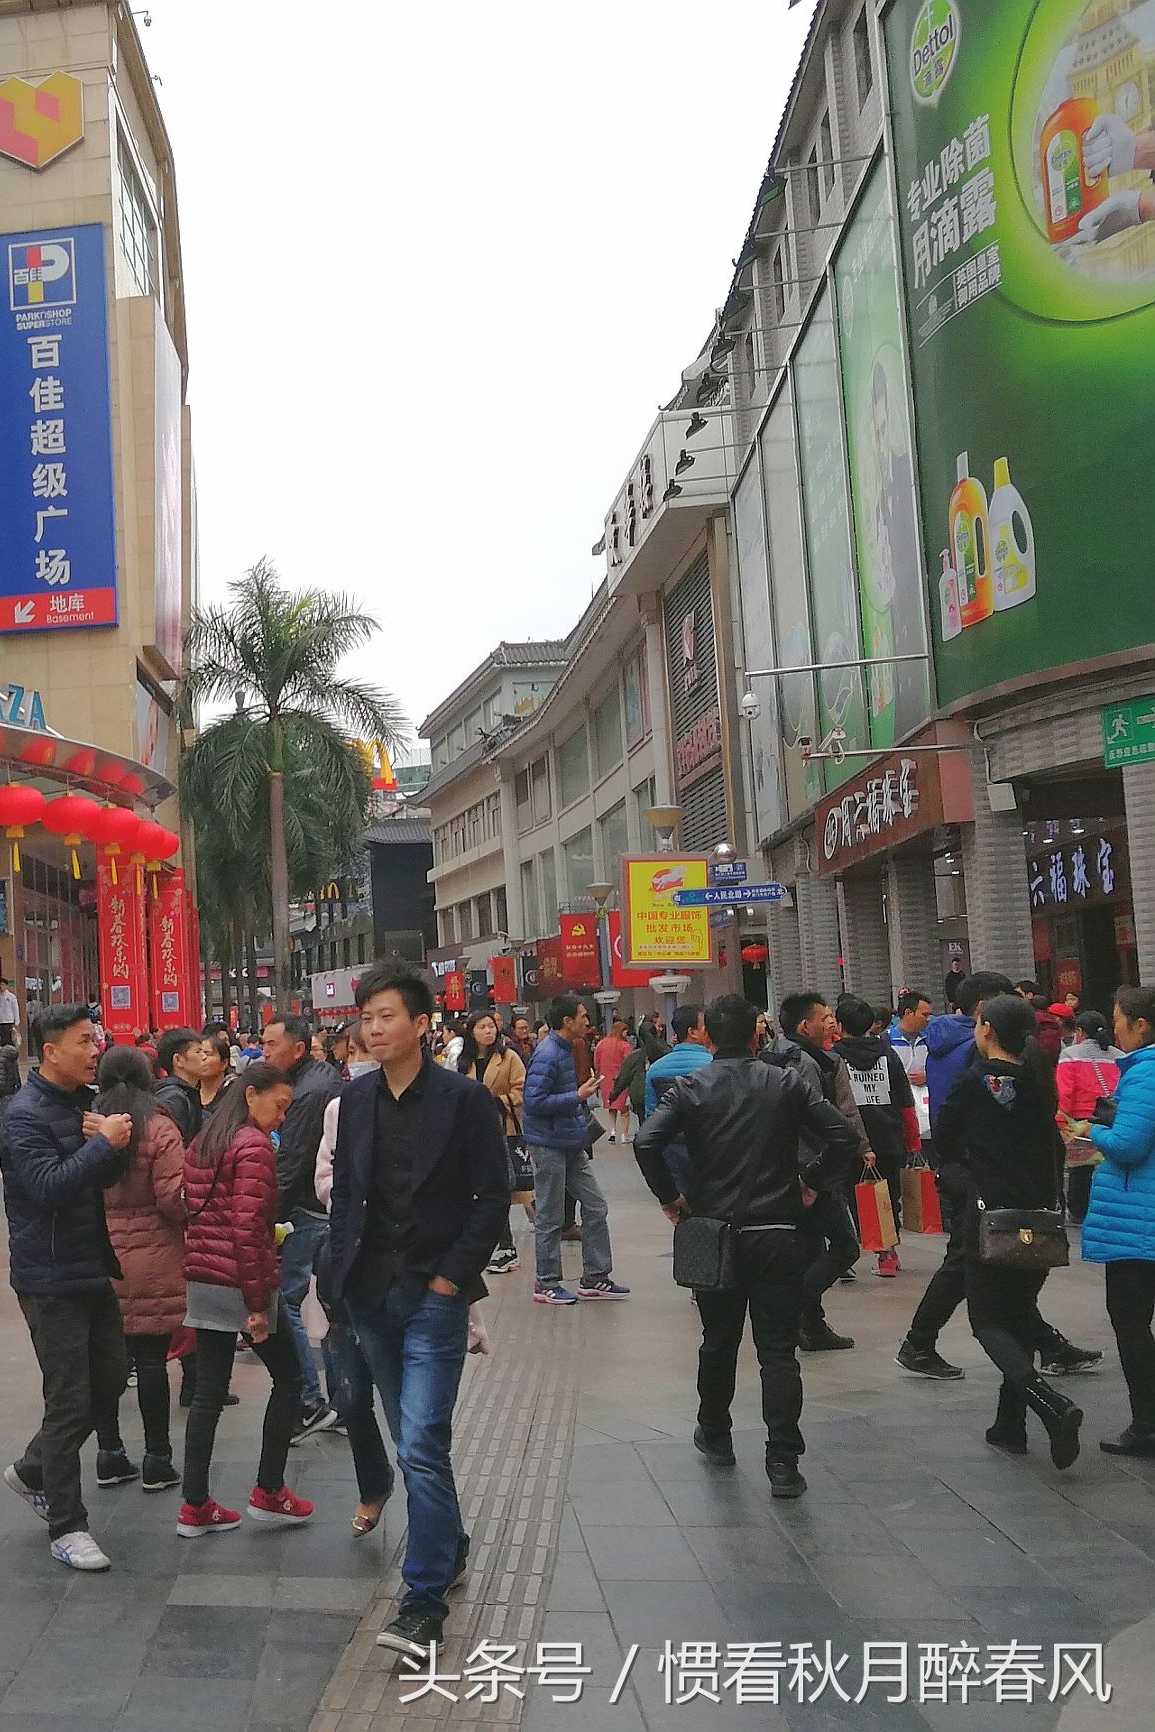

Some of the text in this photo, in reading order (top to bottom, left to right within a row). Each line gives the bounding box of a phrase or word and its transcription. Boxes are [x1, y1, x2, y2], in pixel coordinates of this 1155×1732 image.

[914, 13, 954, 77] Dettol
[907, 113, 991, 222] 专业除菌
[912, 167, 998, 290] 用滴露
[27, 333, 72, 586] 百佳超级广场
[49, 592, 85, 613] 地库
[46, 611, 94, 624] Basement
[646, 923, 694, 934] 批发市场
[853, 1073, 885, 1082] RUINED
[863, 1083, 876, 1093] MY
